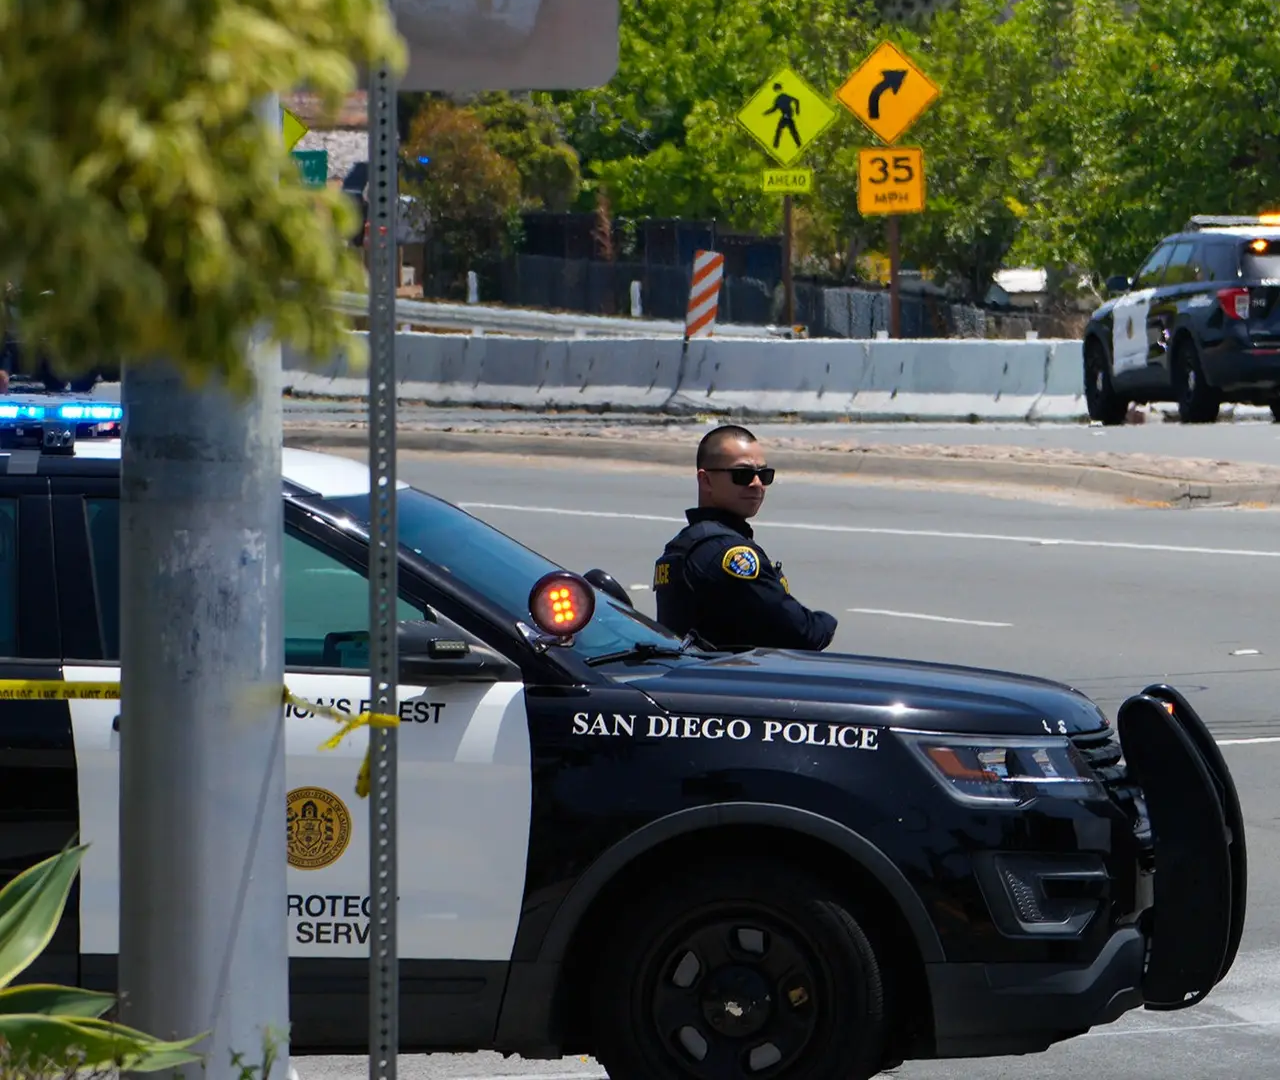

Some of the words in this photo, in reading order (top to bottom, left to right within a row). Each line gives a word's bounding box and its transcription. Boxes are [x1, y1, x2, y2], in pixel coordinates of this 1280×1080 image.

[767, 174, 806, 187] AHEAD
[868, 156, 915, 185] 35
[874, 192, 909, 205] MPH
[359, 699, 446, 724] FEST
[572, 712, 637, 736] SAN
[646, 715, 751, 740] DIEGO
[762, 721, 879, 751] POLICE
[296, 921, 371, 944] SERV
